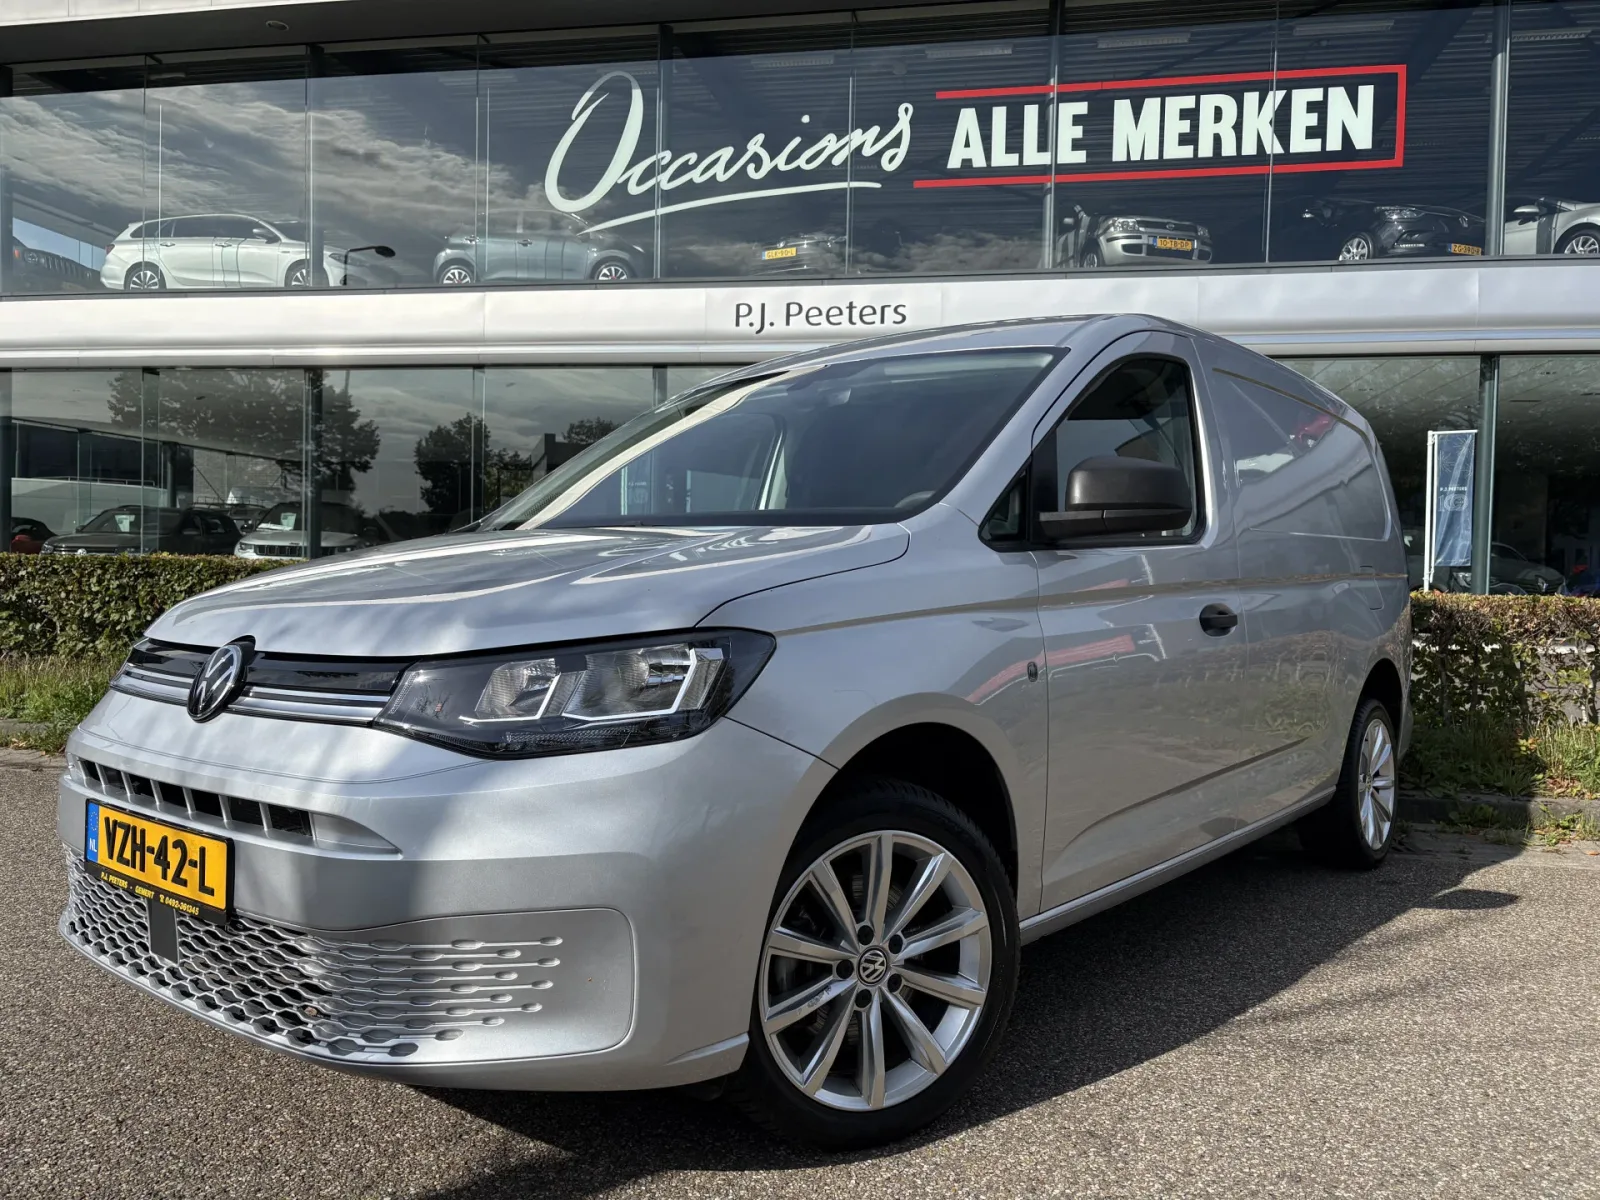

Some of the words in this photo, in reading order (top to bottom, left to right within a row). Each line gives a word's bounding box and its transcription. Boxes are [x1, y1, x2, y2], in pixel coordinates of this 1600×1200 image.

[544, 71, 914, 213] Occasions
[946, 101, 1089, 169] ALLE
[1111, 85, 1375, 162] MERKEN
[735, 302, 775, 335] P.J.
[785, 301, 907, 327] Peeters
[89, 837, 98, 853] NL
[104, 816, 215, 897] VZH-42-L
[109, 874, 128, 889] PEETERS
[135, 885, 155, 899] GEMERT
